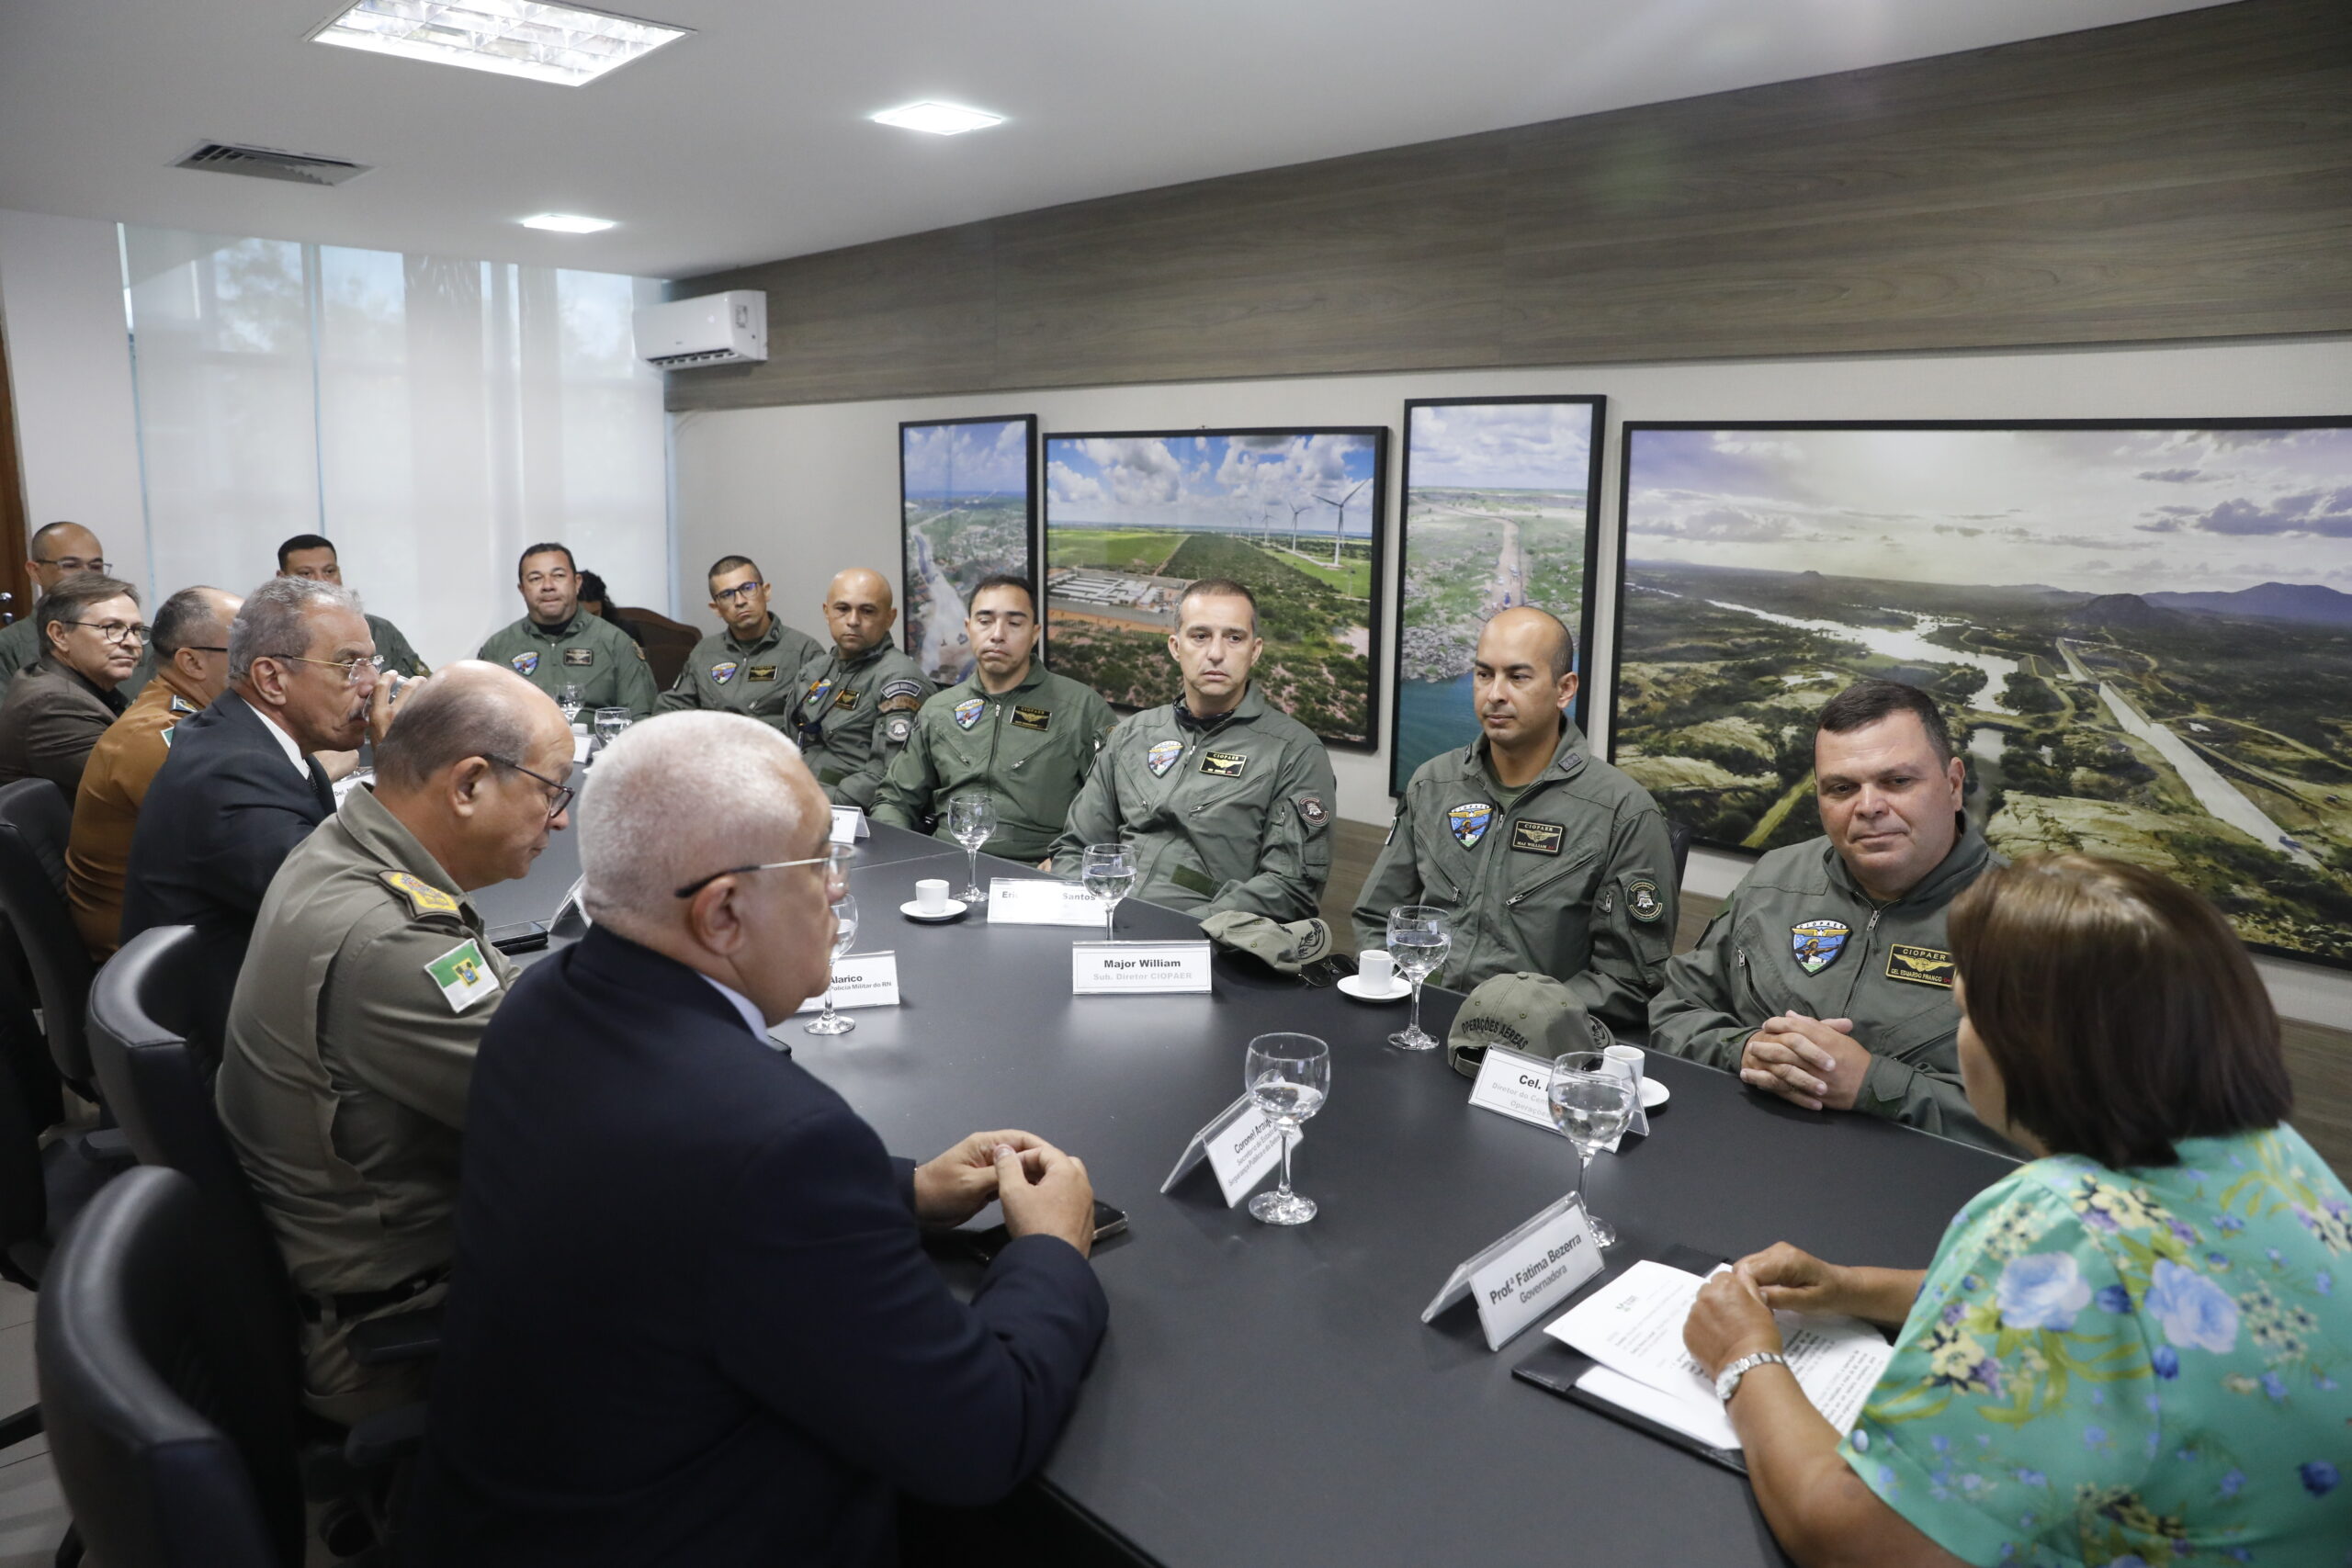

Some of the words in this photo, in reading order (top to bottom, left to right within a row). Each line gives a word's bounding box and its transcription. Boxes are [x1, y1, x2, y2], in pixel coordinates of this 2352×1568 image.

[1524, 823, 1554, 832] CIOPAER
[1062, 892, 1096, 901] Santos
[1903, 948, 1947, 961] CIOPAER
[1103, 959, 1136, 970] Major
[1138, 959, 1182, 967] William
[830, 975, 863, 985] Alarico
[1093, 973, 1114, 981] Sub.
[1116, 973, 1148, 981] Diretor
[1150, 972, 1193, 980] CIOPAER
[1900, 969, 1922, 979] EDUARDO
[1922, 973, 1943, 983] FRANCO
[1461, 1016, 1499, 1034] OPERAÇÕES
[1498, 1023, 1529, 1050] AÉREAS
[1519, 1074, 1542, 1090] Cel.
[1492, 1081, 1519, 1096] Diretor
[1519, 1090, 1530, 1100] do
[1234, 1129, 1254, 1154] Coronel
[1515, 1258, 1549, 1286] Fátima
[1546, 1234, 1582, 1264] Bezerra
[1520, 1264, 1567, 1303] Governadora
